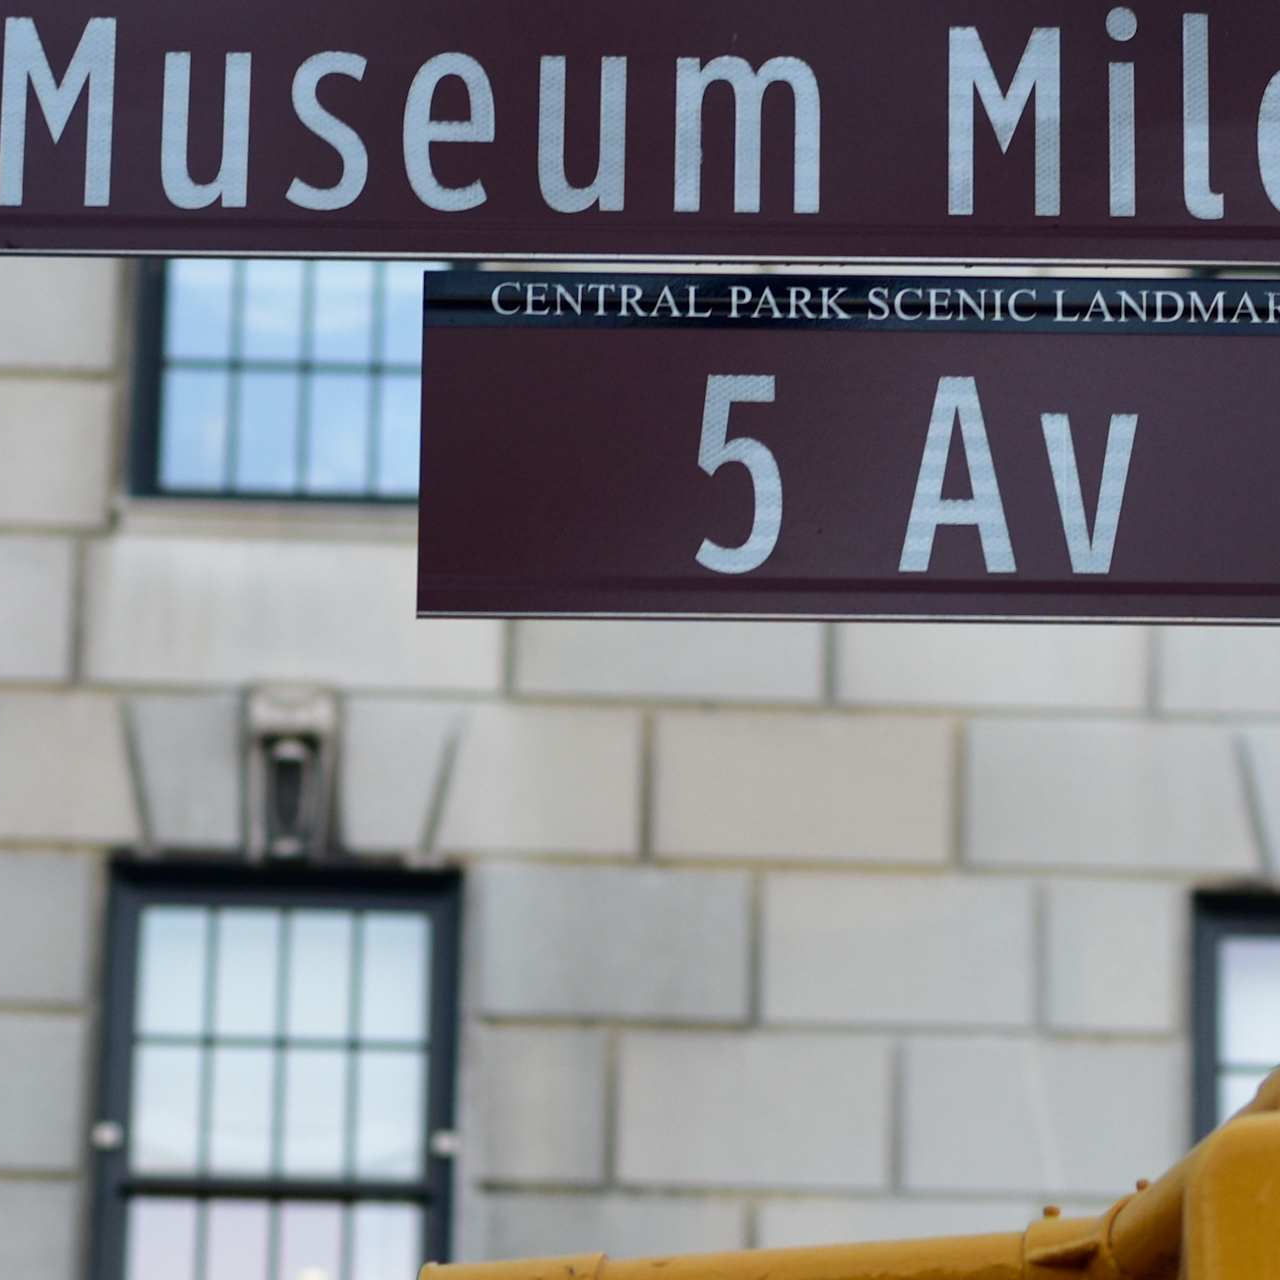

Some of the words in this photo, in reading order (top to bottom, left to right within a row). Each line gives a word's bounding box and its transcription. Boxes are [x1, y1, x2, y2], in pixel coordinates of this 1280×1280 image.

[491, 281, 712, 318] CENTRAL
[728, 285, 852, 320] PARK
[867, 286, 1037, 322] SCENIC
[695, 374, 783, 574] 5
[898, 375, 1139, 574] Av
